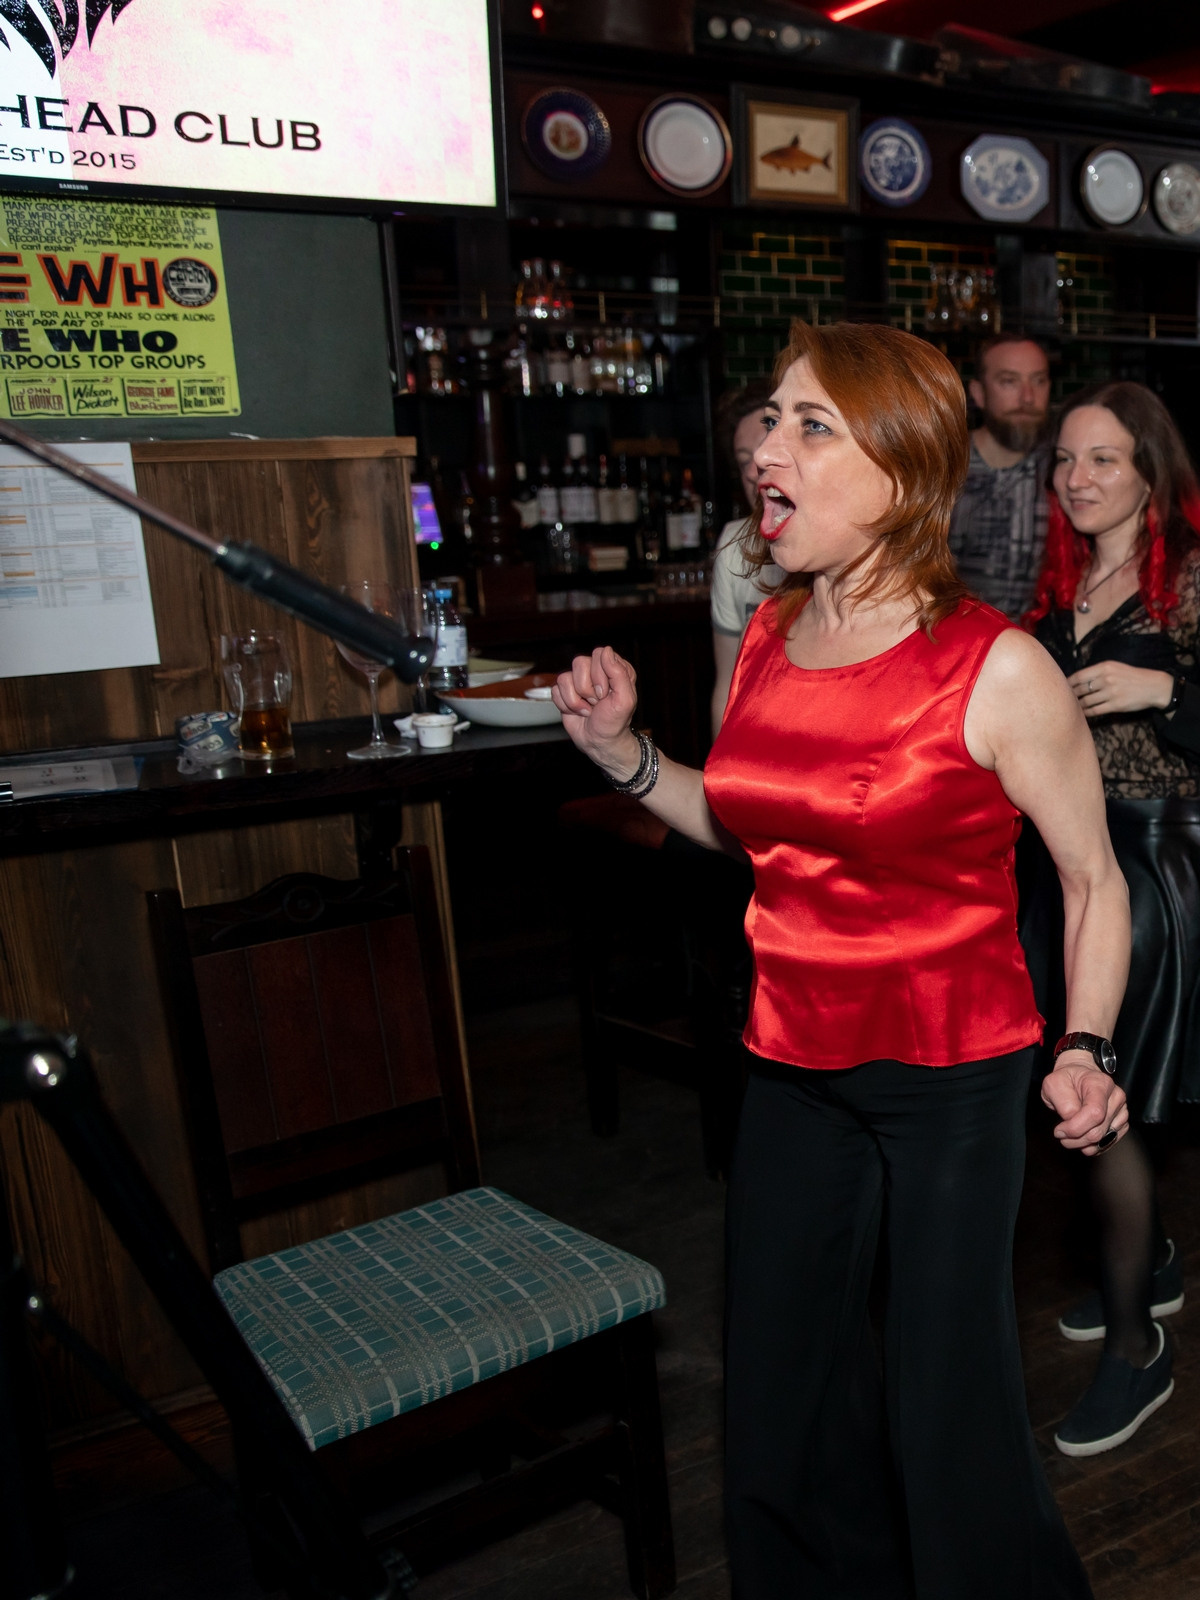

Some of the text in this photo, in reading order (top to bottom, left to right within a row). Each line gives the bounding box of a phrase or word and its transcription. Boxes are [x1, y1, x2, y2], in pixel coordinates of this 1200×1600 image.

[174, 110, 322, 151] CLUB
[73, 150, 136, 170] 2015
[59, 183, 89, 191] SAMSUNG
[3, 202, 32, 211] MANY
[79, 205, 106, 214] ONCE
[110, 206, 140, 216] AGAIN
[143, 208, 156, 217] WE
[159, 209, 177, 218] ARE
[180, 211, 211, 220] DOING
[5, 211, 25, 219] THIS
[29, 211, 57, 220] WHEN
[60, 213, 75, 221] ON
[79, 214, 116, 224] SUNDAY
[6, 218, 45, 229] PRESENT
[48, 220, 65, 229] THE
[68, 221, 92, 231] FIRST
[7, 226, 20, 235] OF
[22, 227, 40, 236] ONE
[44, 229, 57, 237] OF
[116, 231, 134, 239] TOP
[9, 234, 62, 244] RECORDERS
[194, 242, 214, 250] AND
[5, 310, 215, 322] NIGHT FOR ALL POP FANS SO COME ALONG
[6, 318, 24, 327] THE
[32, 319, 57, 327] POP
[44, 329, 178, 353] WHO
[88, 355, 124, 368] TOP
[131, 356, 206, 369] GROUPS
[73, 384, 112, 400] Wilson
[12, 395, 64, 411] LEE HOOKER
